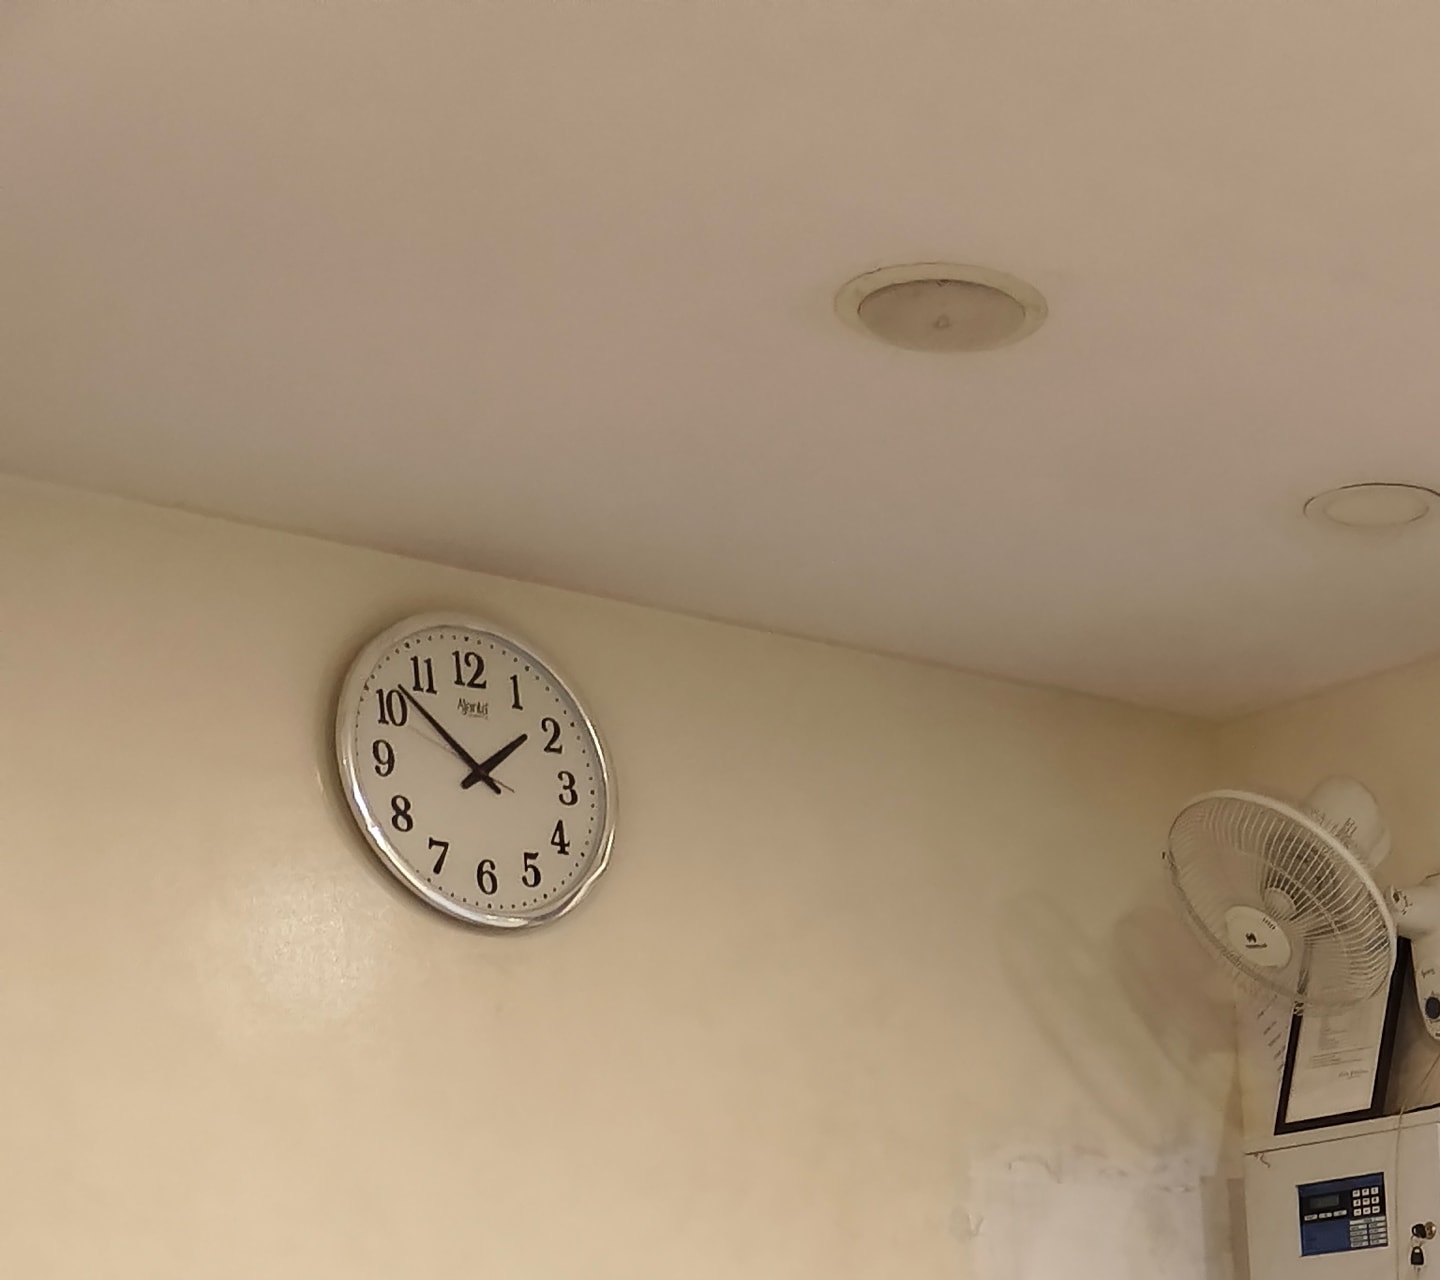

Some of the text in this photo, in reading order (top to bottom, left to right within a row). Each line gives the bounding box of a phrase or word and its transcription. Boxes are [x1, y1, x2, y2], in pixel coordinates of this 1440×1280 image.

[410, 656, 437, 694] 11
[452, 650, 487, 689] 12
[376, 688, 407, 726] 10
[510, 675, 523, 710] 1
[541, 718, 562, 754] 2
[372, 739, 395, 777] 9
[557, 771, 578, 805] 3
[391, 795, 413, 832] 8
[551, 819, 570, 855] 4
[429, 837, 449, 874] 7
[522, 852, 541, 887] 5
[476, 860, 498, 895] 6
